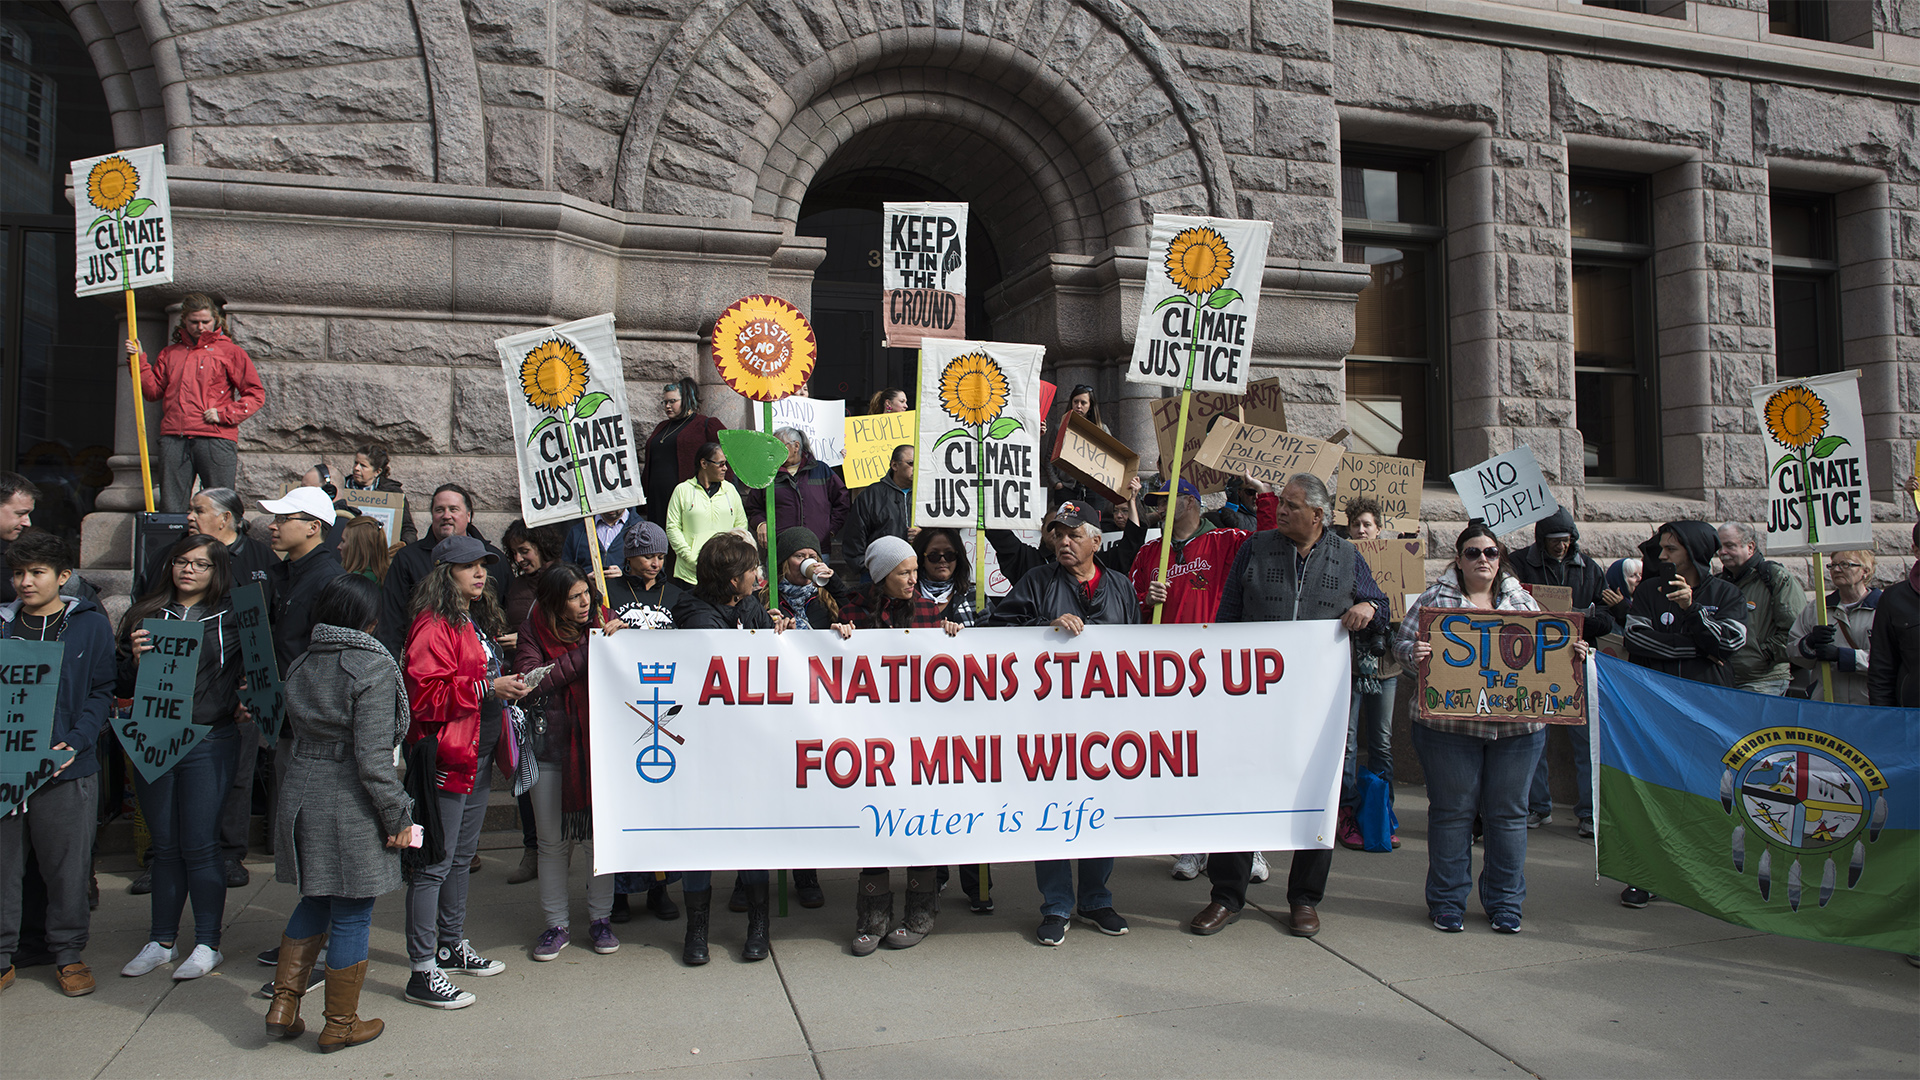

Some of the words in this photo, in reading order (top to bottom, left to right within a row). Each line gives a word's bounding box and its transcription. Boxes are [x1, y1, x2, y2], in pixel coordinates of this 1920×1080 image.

[94, 217, 166, 250] CLIMATE
[890, 214, 957, 253] KEEP
[83, 245, 165, 286] JUSTICE
[894, 251, 913, 269] IT
[918, 252, 937, 270] IN
[900, 270, 936, 289] THE
[890, 290, 956, 330] GROUND
[739, 322, 791, 344] RESIST!
[1162, 307, 1247, 346] CLIMATE
[739, 345, 790, 373] PIPELINES
[755, 342, 775, 355] NO
[1139, 339, 1241, 384] JUSTICE
[539, 414, 627, 463] CLIMATE
[852, 415, 910, 443] PEOPLE
[1235, 426, 1267, 443] NO
[1271, 434, 1318, 455] MPLS
[944, 441, 1032, 478] CLIMATE
[1227, 442, 1300, 469] POLICE!!
[1341, 456, 1364, 473] No
[1368, 460, 1415, 478] special
[531, 450, 632, 510] JUSTICE
[1220, 459, 1247, 473] NO
[1250, 465, 1287, 485] DAPL
[1477, 461, 1517, 495] NO
[1778, 457, 1862, 494] CLIMATE
[347, 490, 388, 505] Sacred
[925, 479, 1031, 519] JUSTICE
[1350, 477, 1377, 496] ops
[1387, 479, 1409, 495] at
[1482, 484, 1545, 528] DAPL!
[1767, 490, 1862, 533] JUSTICE
[236, 606, 260, 630] KEEP
[151, 635, 198, 657] KEEP
[251, 652, 261, 663] in
[1440, 614, 1571, 674] STOP
[0, 664, 51, 684] KEEP
[163, 659, 178, 674] it
[247, 667, 271, 692] THE
[698, 655, 794, 705] ALL
[808, 651, 1019, 704] NATIONS
[1033, 647, 1207, 702] STANDS
[1221, 648, 1285, 696] UP
[1479, 669, 1519, 689] THE
[11, 688, 28, 705] it
[158, 679, 173, 691] in
[7, 711, 24, 723] in
[143, 696, 184, 720] THE
[245, 691, 283, 736] GROUND
[122, 721, 195, 767] GROUND
[796, 737, 897, 788] FOR
[910, 734, 1002, 786] MNI
[1017, 729, 1199, 782] WICONI
[1728, 731, 1782, 766] MENDOTA
[1785, 730, 1882, 787] MDEWAKANTON
[861, 804, 985, 838] Water
[997, 802, 1024, 833] is
[1035, 797, 1106, 842] Life
